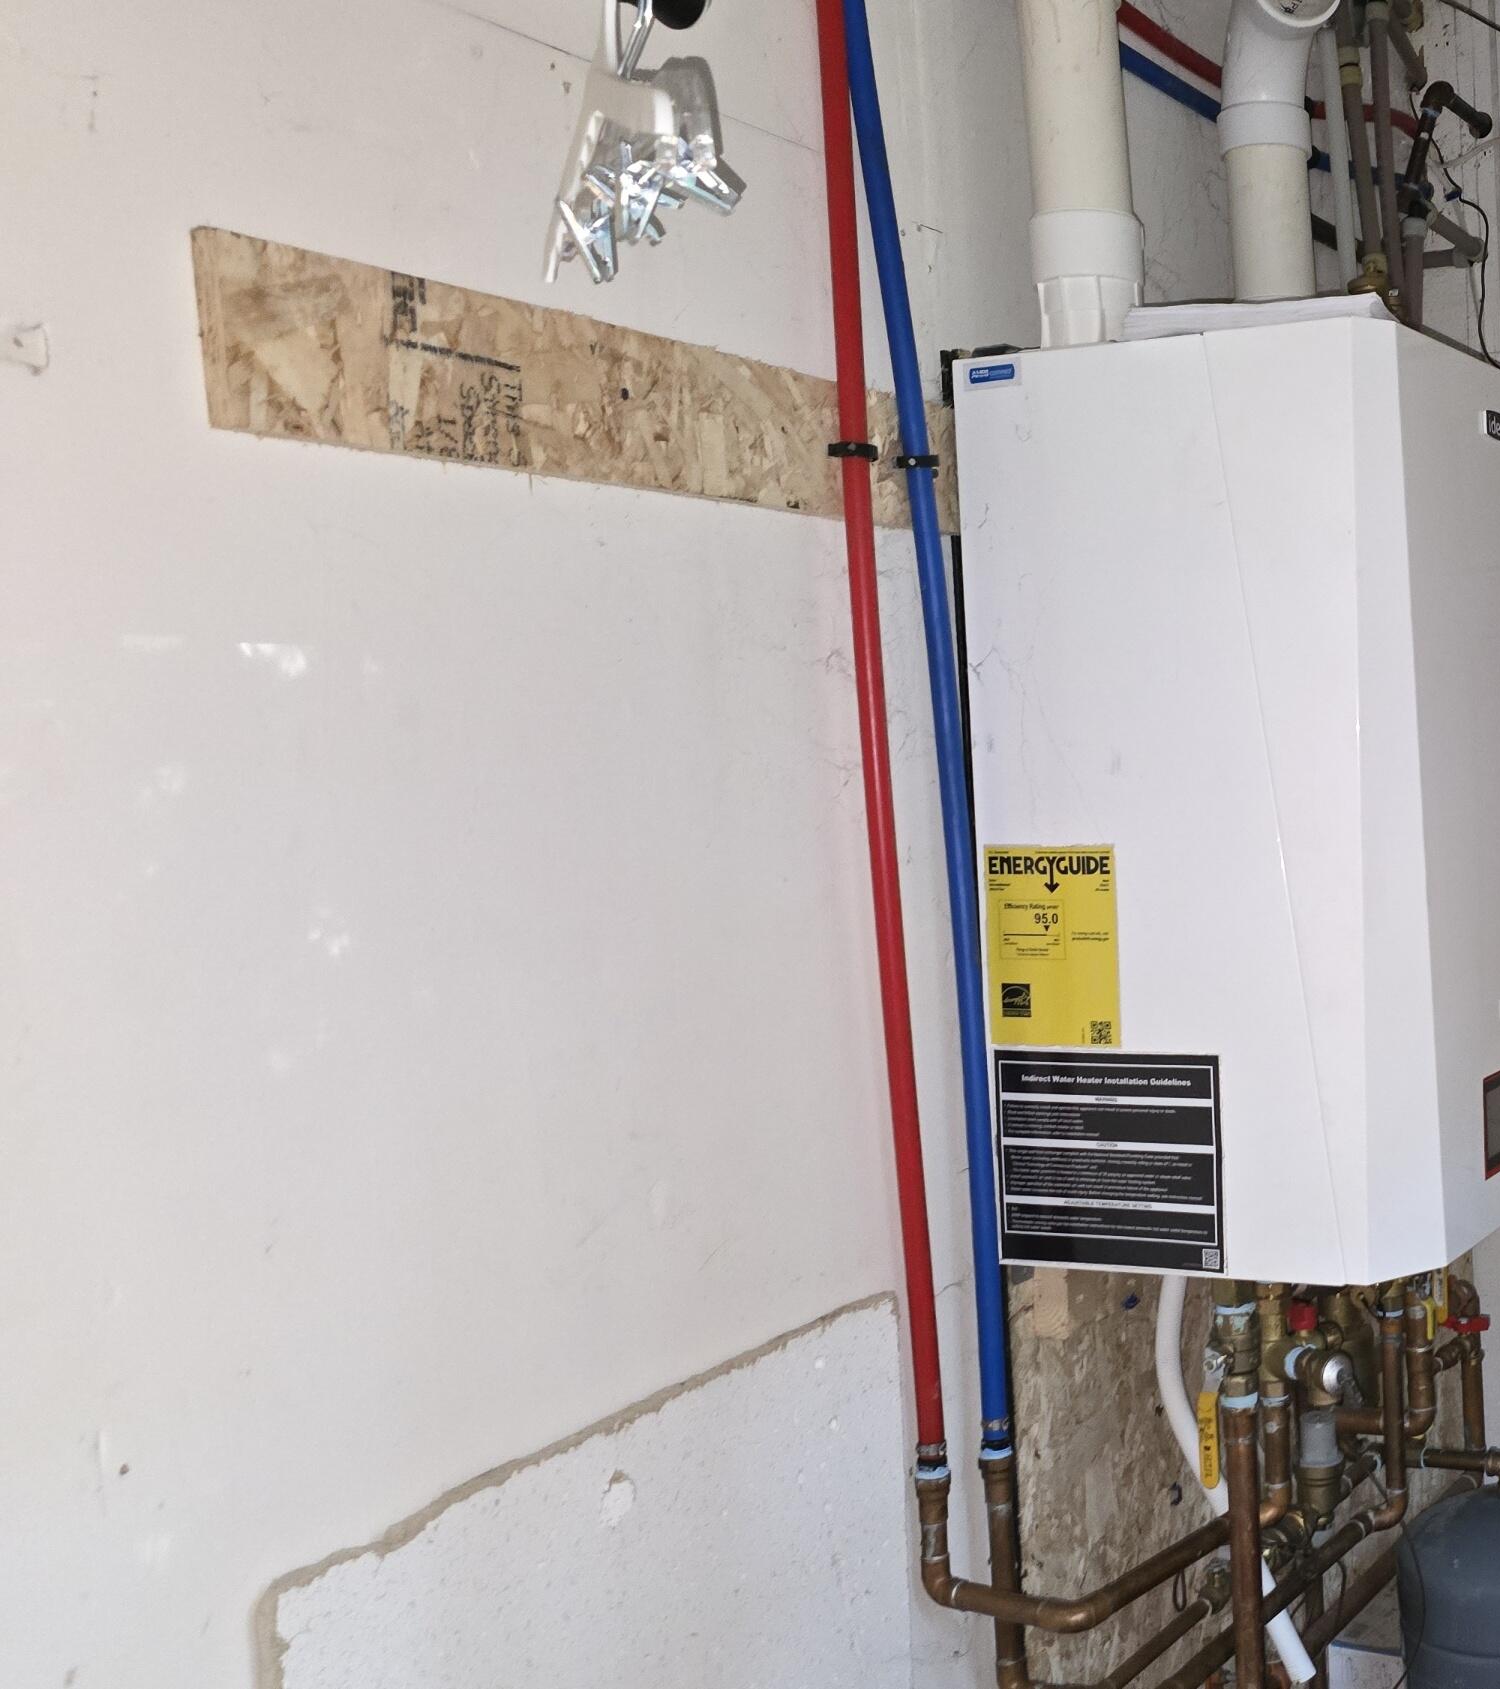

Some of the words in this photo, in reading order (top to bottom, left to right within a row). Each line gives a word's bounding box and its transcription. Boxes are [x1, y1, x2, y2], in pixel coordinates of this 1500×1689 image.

[988, 856, 1110, 878] ENERGYGUIDE
[1034, 913, 1059, 925] 95.0
[1021, 1074, 1051, 1083] Indirect
[1052, 1075, 1075, 1084] Water
[1076, 1076, 1103, 1085] Heater
[1104, 1077, 1148, 1086] Installation
[1149, 1078, 1192, 1087] Guidelines
